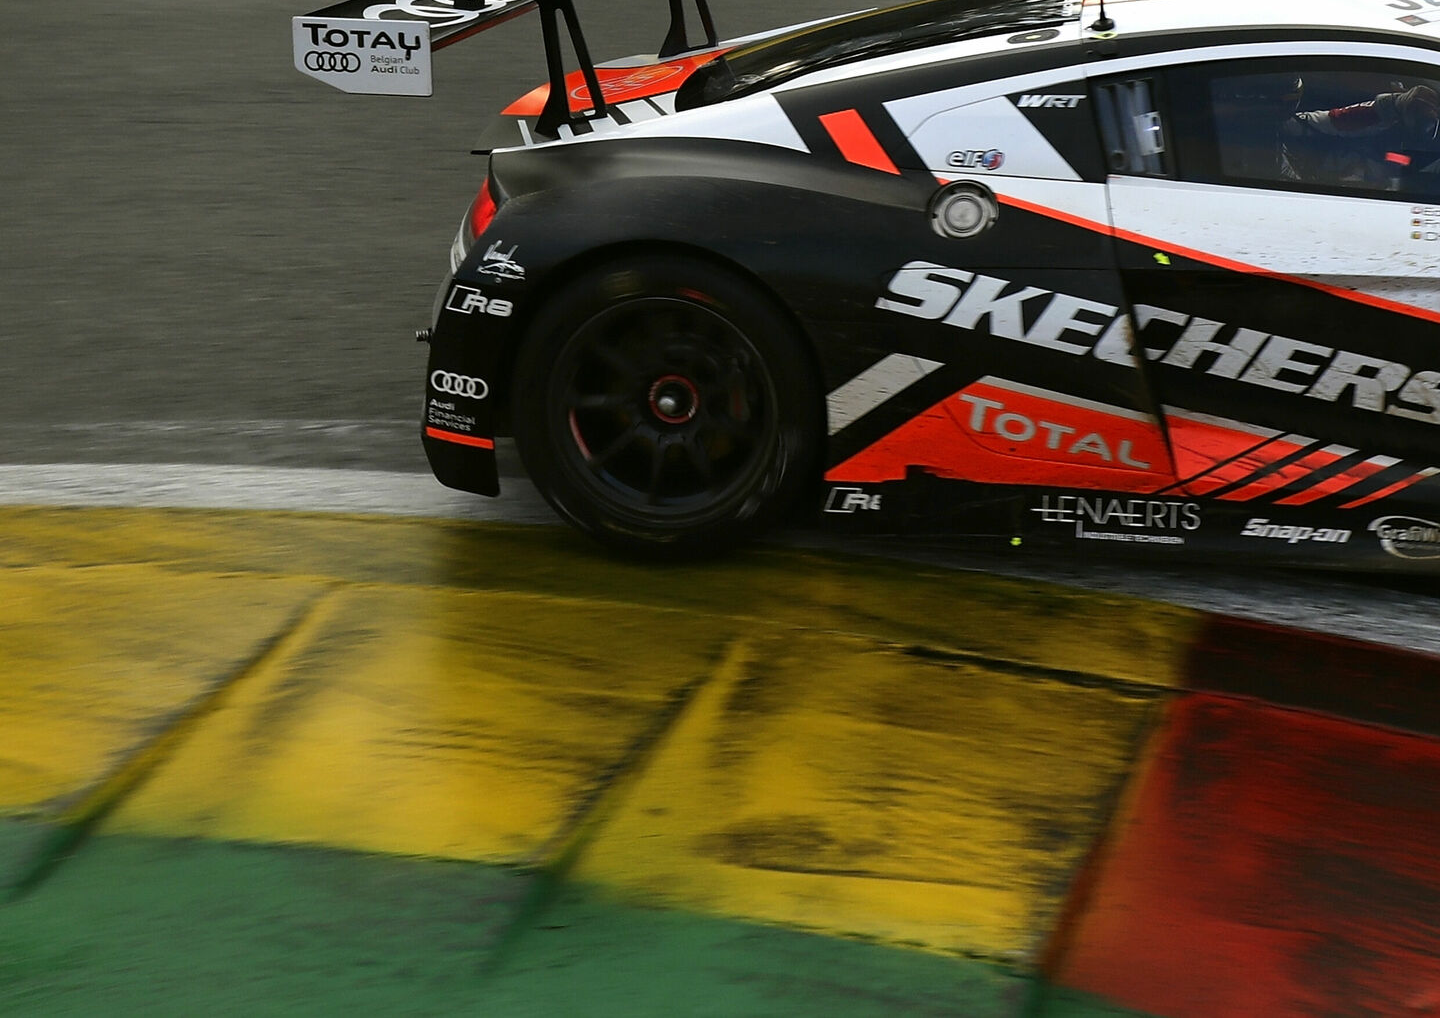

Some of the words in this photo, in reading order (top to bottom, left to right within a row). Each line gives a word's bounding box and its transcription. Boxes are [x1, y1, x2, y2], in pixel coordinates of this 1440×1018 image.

[370, 54, 404, 65] Belgian
[370, 65, 398, 74] Audi
[400, 65, 420, 75] Club
[1017, 94, 1087, 108] WRT
[461, 293, 514, 317] R8
[429, 398, 455, 411] Audi
[428, 414, 471, 431] Services
[429, 407, 476, 425] Financial
[959, 393, 1151, 471] TOTAL
[1042, 495, 1202, 531] LENAERTS
[1240, 518, 1352, 544] Snap-on
